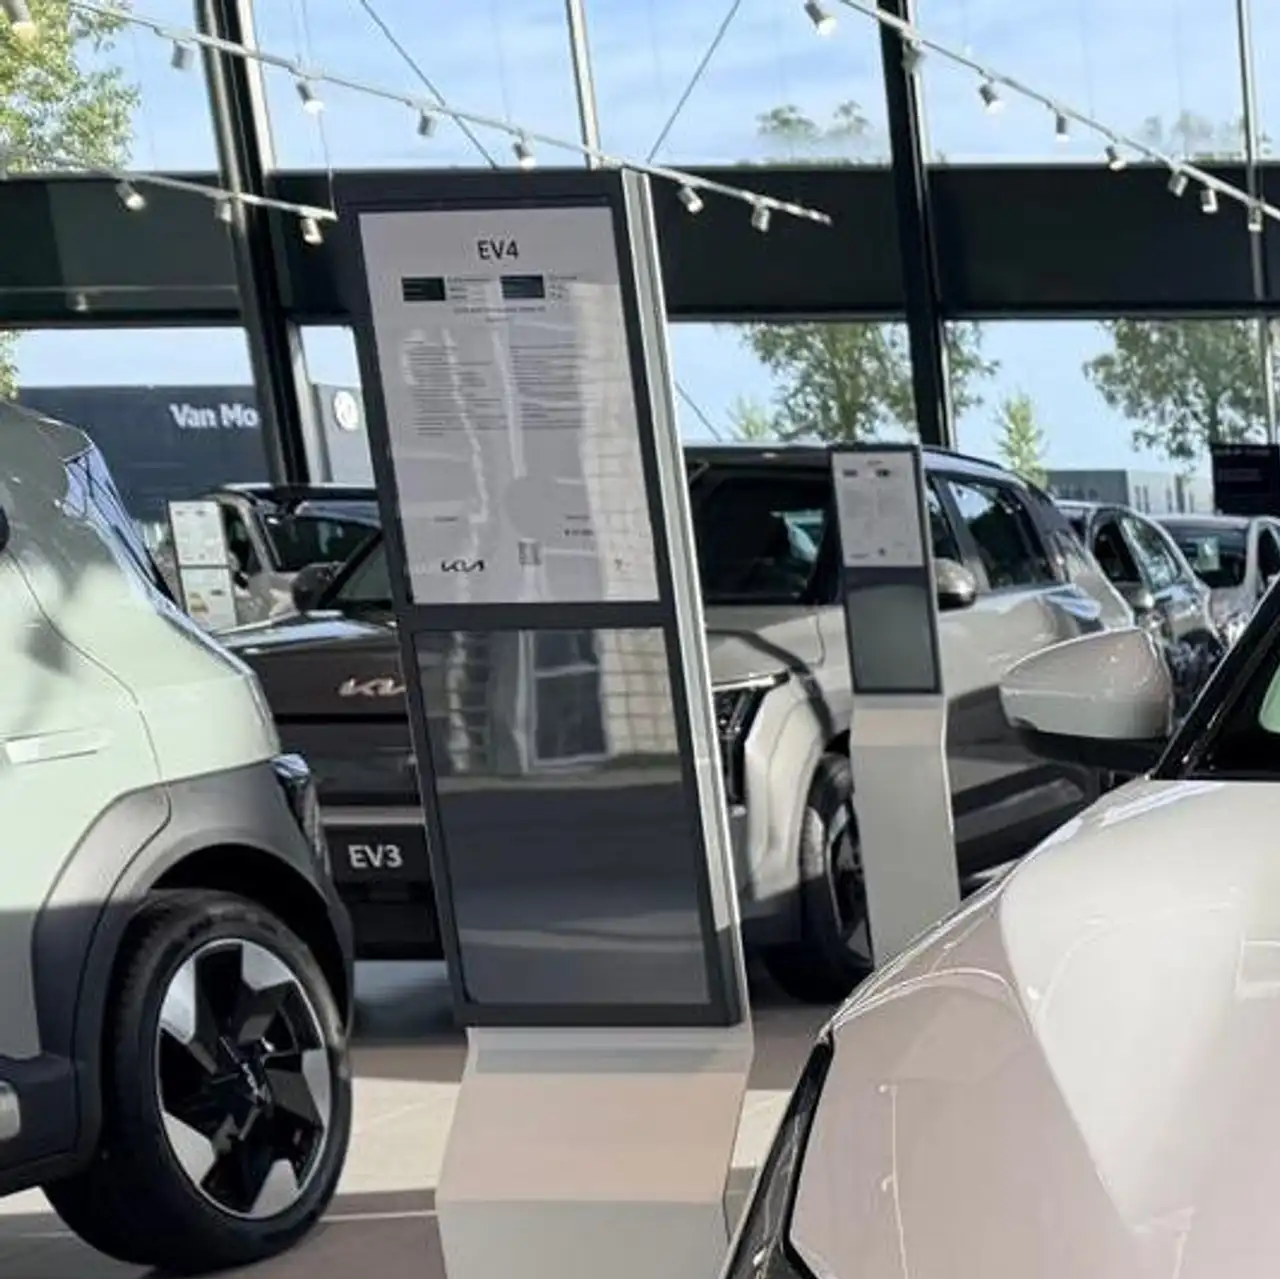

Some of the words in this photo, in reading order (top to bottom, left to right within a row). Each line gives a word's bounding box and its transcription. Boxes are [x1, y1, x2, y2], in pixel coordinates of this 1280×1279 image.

[477, 239, 520, 261] EV4
[169, 402, 218, 429] Van
[348, 844, 403, 868] EV3
